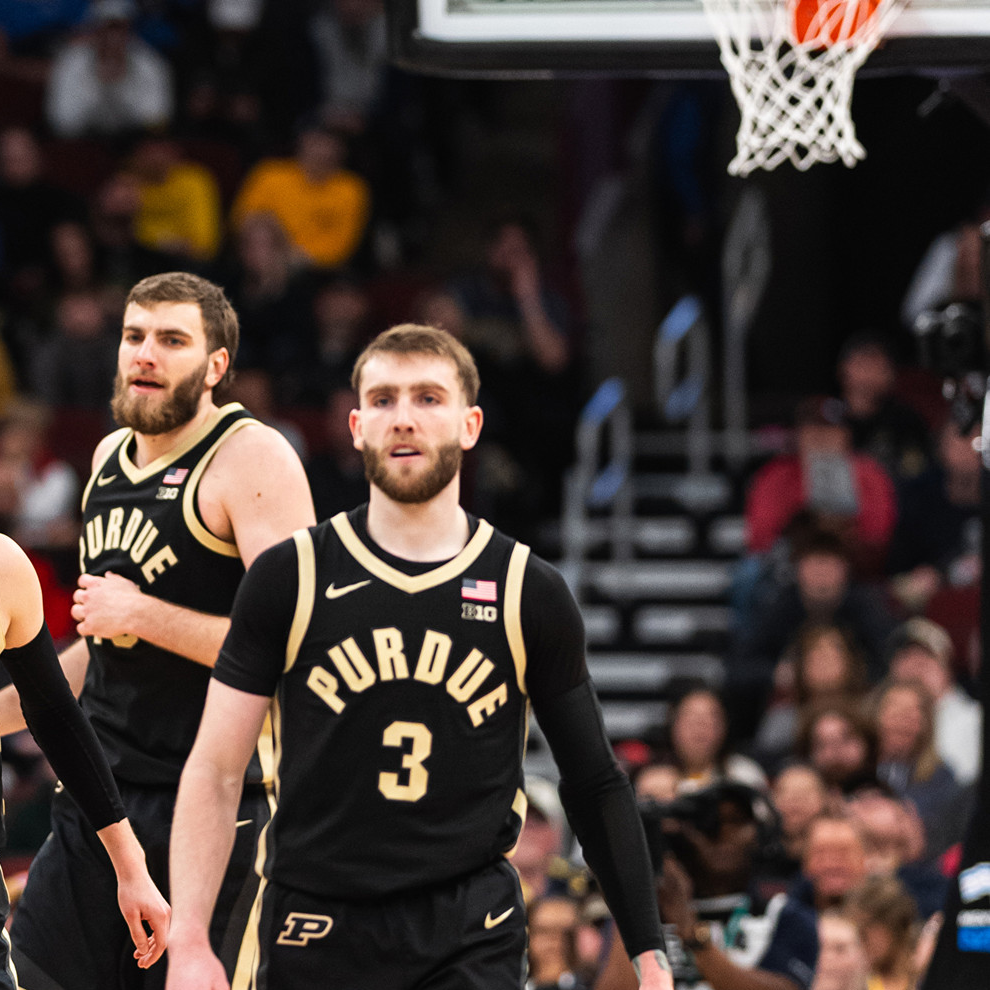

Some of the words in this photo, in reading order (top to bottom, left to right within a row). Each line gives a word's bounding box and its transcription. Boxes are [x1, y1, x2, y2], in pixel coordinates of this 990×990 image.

[306, 627, 508, 728] PURDUE
[378, 720, 432, 802] 3
[276, 912, 333, 946] P
